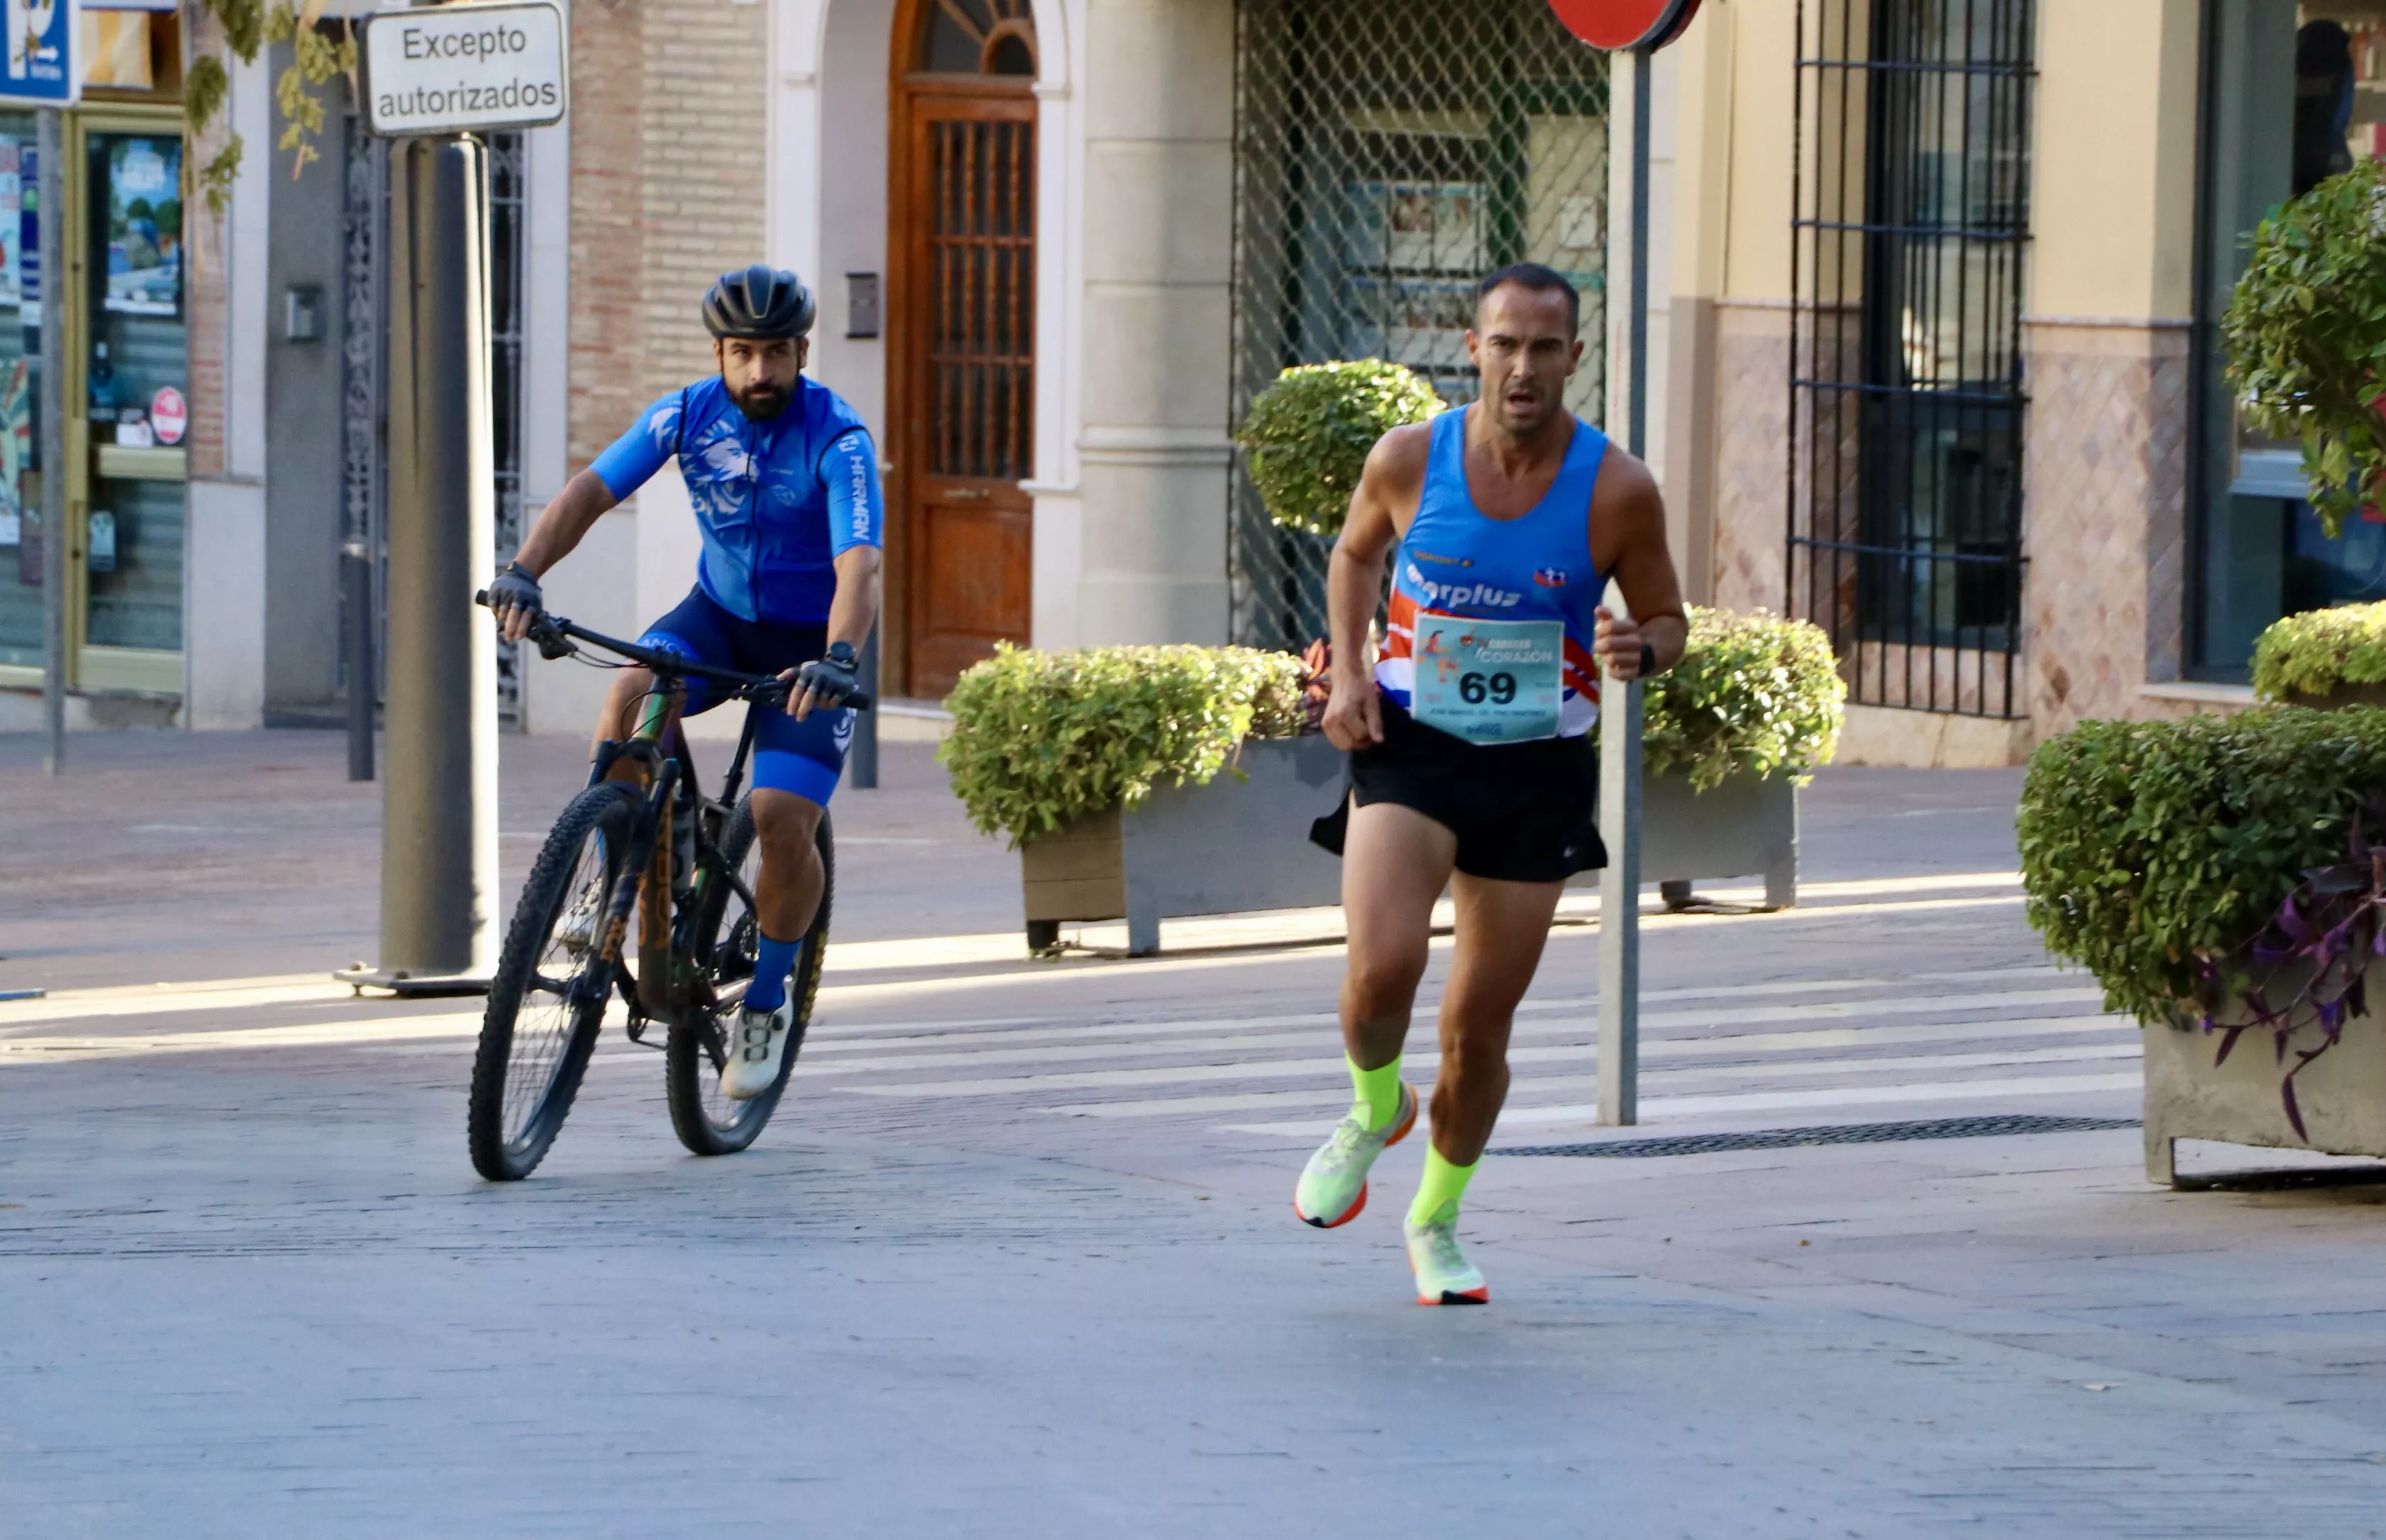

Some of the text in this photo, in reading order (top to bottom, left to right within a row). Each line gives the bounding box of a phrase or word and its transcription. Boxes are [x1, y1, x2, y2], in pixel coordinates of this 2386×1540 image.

[402, 23, 526, 64] Excepto
[378, 76, 558, 118] autorizados
[1459, 671, 1517, 706] 69
